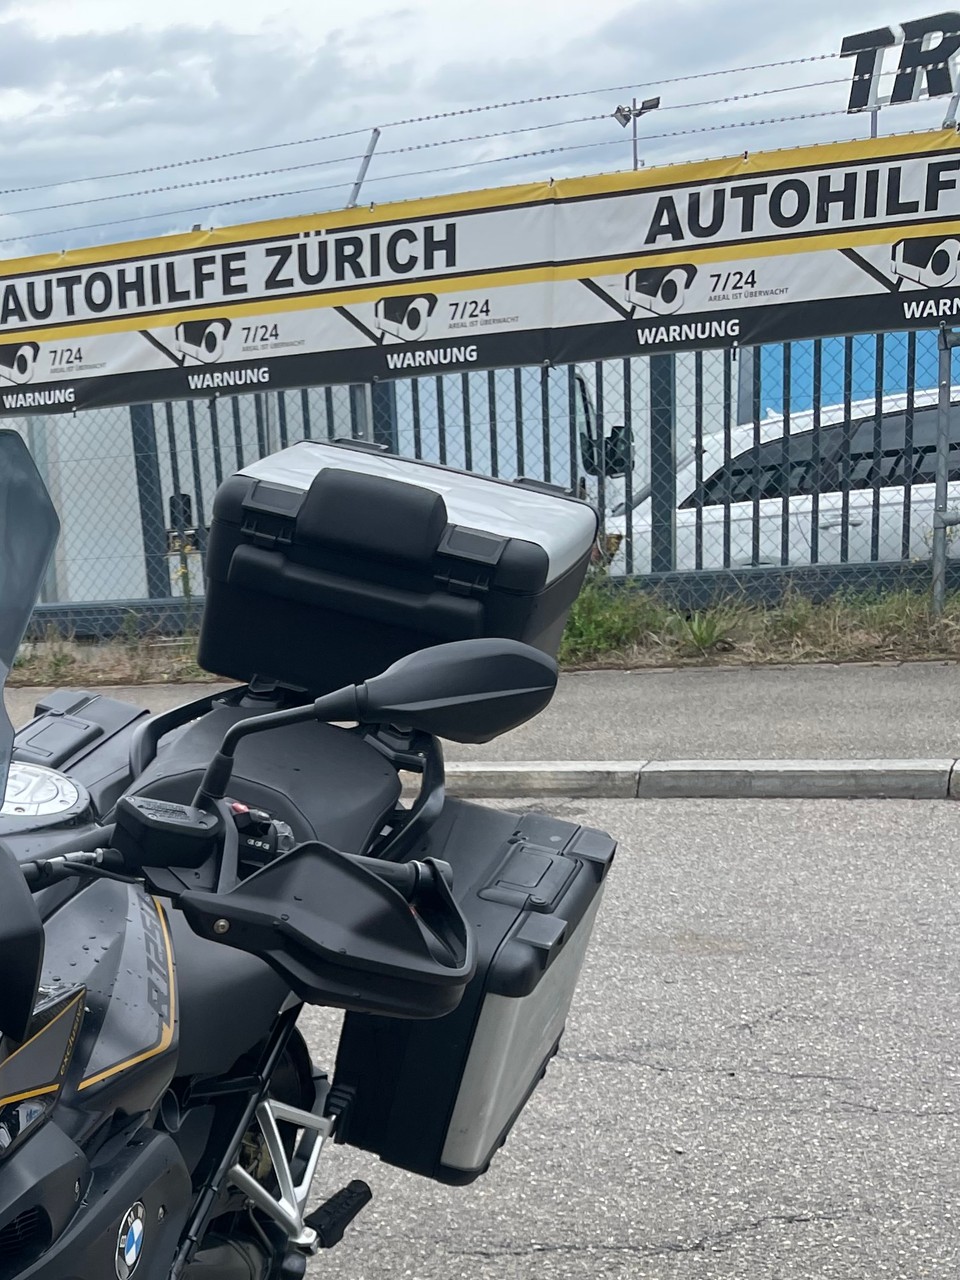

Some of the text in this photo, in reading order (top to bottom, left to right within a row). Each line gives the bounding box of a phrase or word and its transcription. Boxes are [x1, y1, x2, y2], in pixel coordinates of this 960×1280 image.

[0, 222, 457, 325] AUTOHILFE ZÜRICH
[709, 270, 757, 293] 7/24
[708, 287, 789, 302] AREAL IST ÜBERWACHT
[449, 299, 490, 321] 7/24
[242, 323, 279, 344] 7/24
[637, 319, 740, 345] WARNUNG
[49, 347, 83, 366] 7/24
[386, 345, 478, 369] WARNUNG
[188, 367, 269, 390] WARNUNG
[3, 388, 75, 409] WARNUNG
